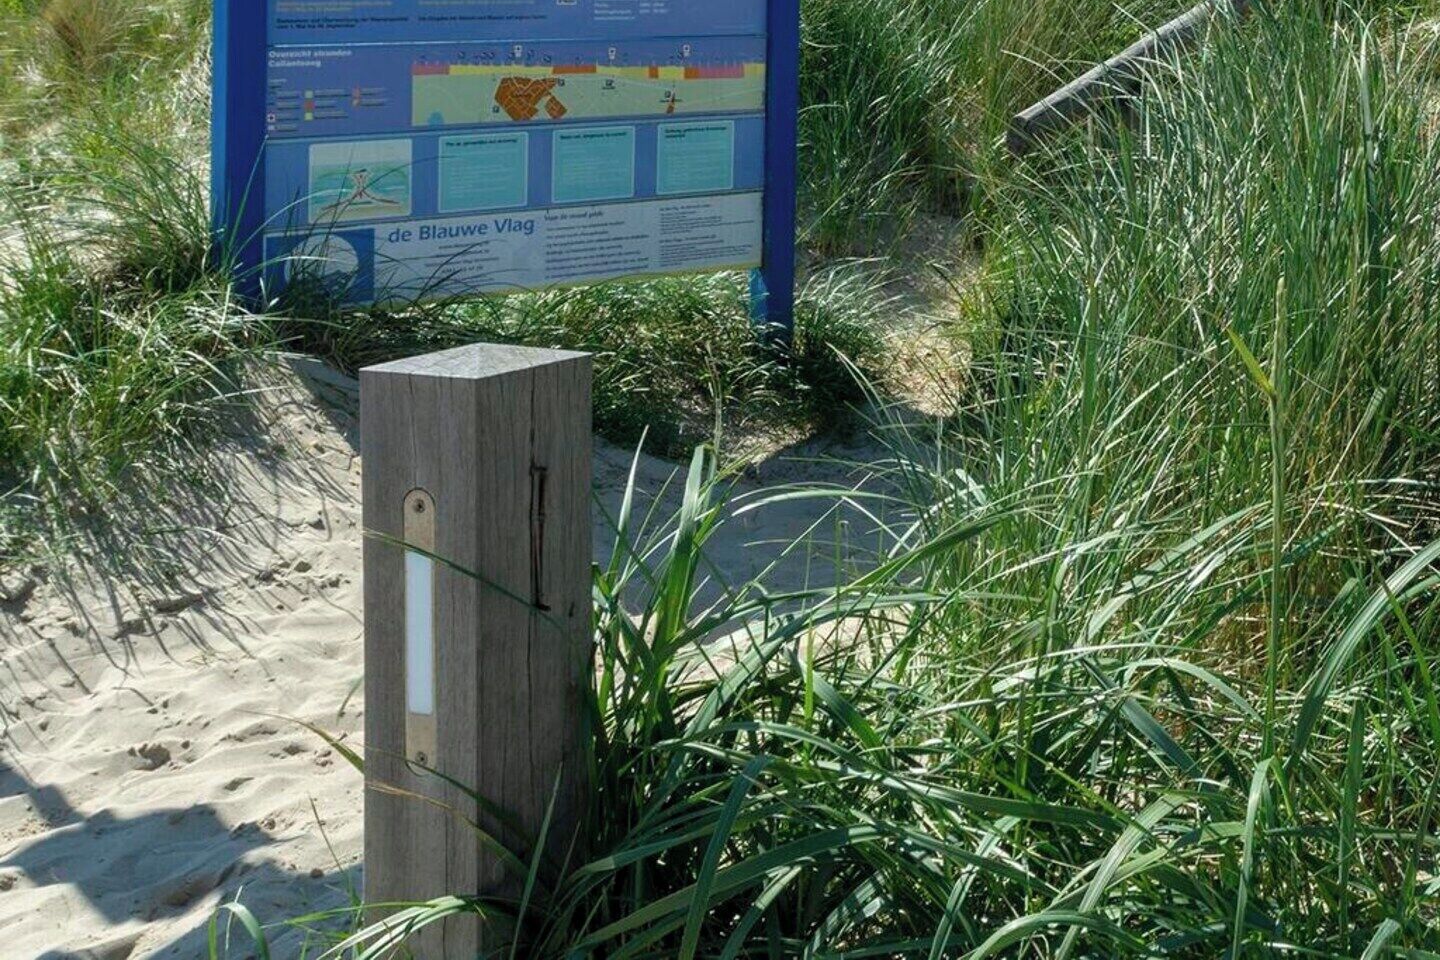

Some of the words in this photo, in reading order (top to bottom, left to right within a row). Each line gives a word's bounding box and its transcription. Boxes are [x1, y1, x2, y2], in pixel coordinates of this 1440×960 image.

[388, 228, 412, 244] de
[419, 220, 488, 241] Blauwe
[494, 217, 535, 235] Vlag
